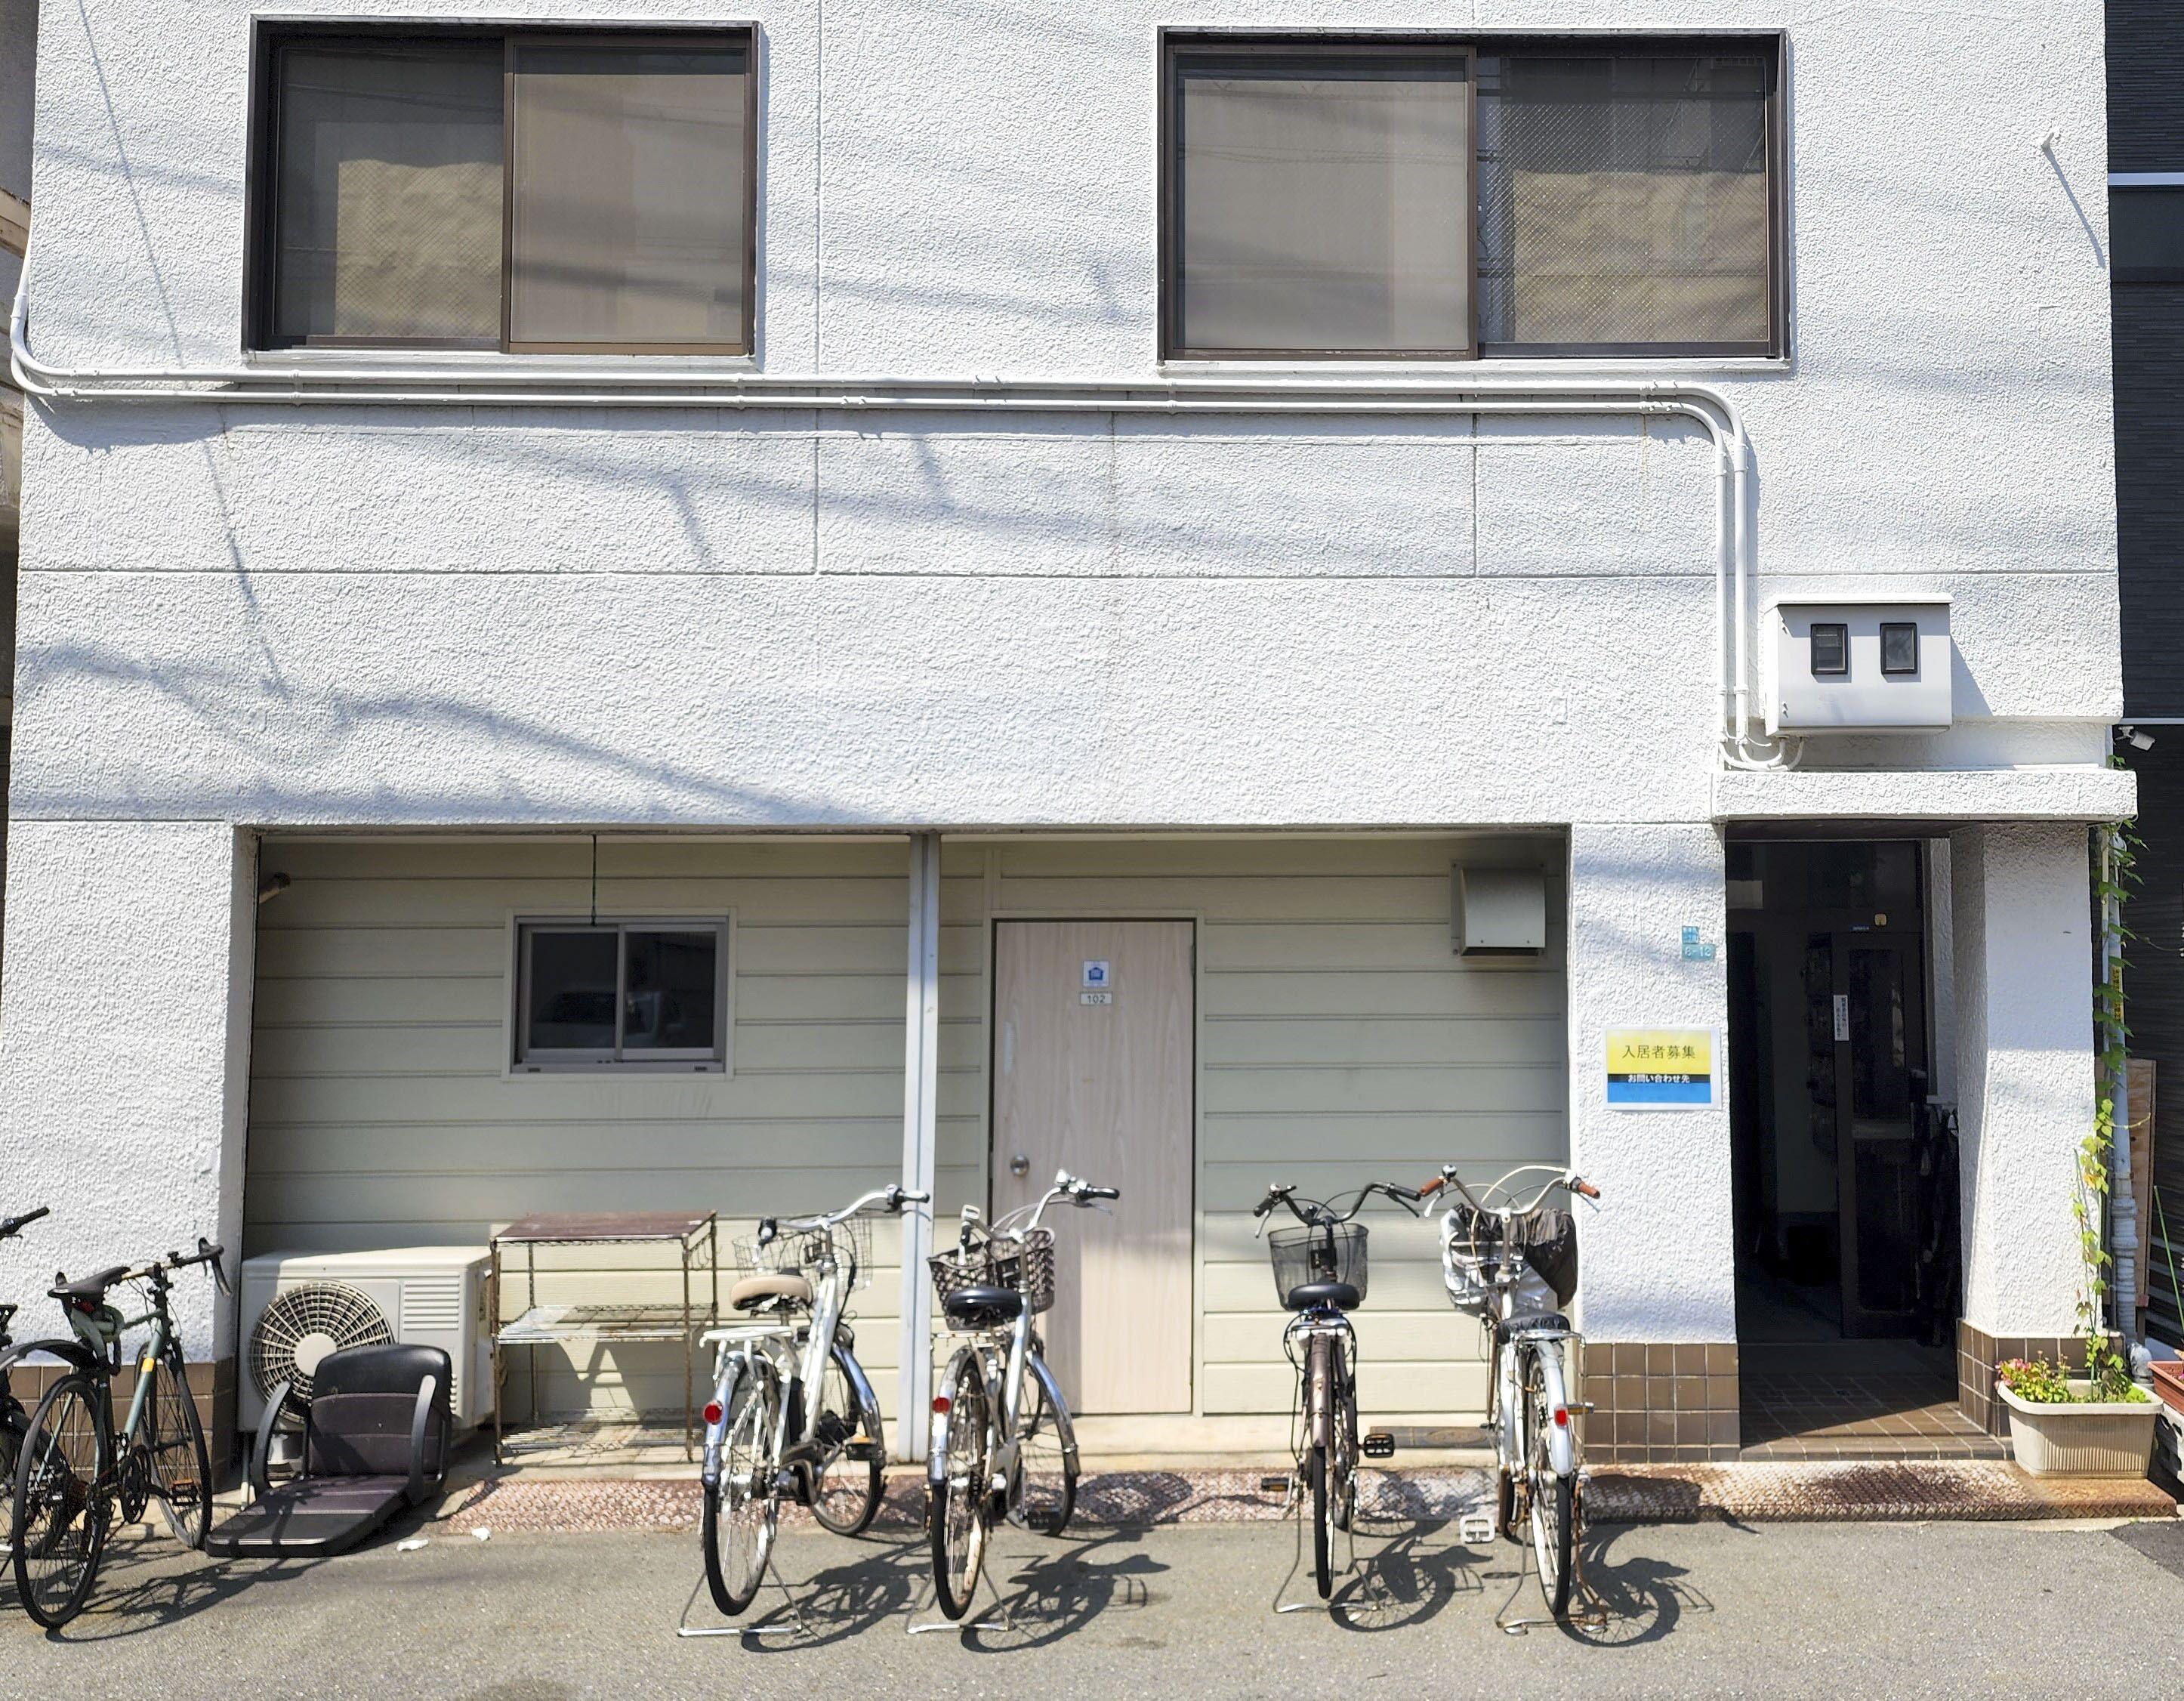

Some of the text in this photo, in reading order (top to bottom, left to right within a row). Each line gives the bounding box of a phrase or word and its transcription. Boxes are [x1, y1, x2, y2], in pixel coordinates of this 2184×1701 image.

[1087, 995, 1106, 1004] 102
[1622, 1045, 1695, 1059] 入居者募集
[1628, 1074, 1690, 1083] お問い合わせ先
